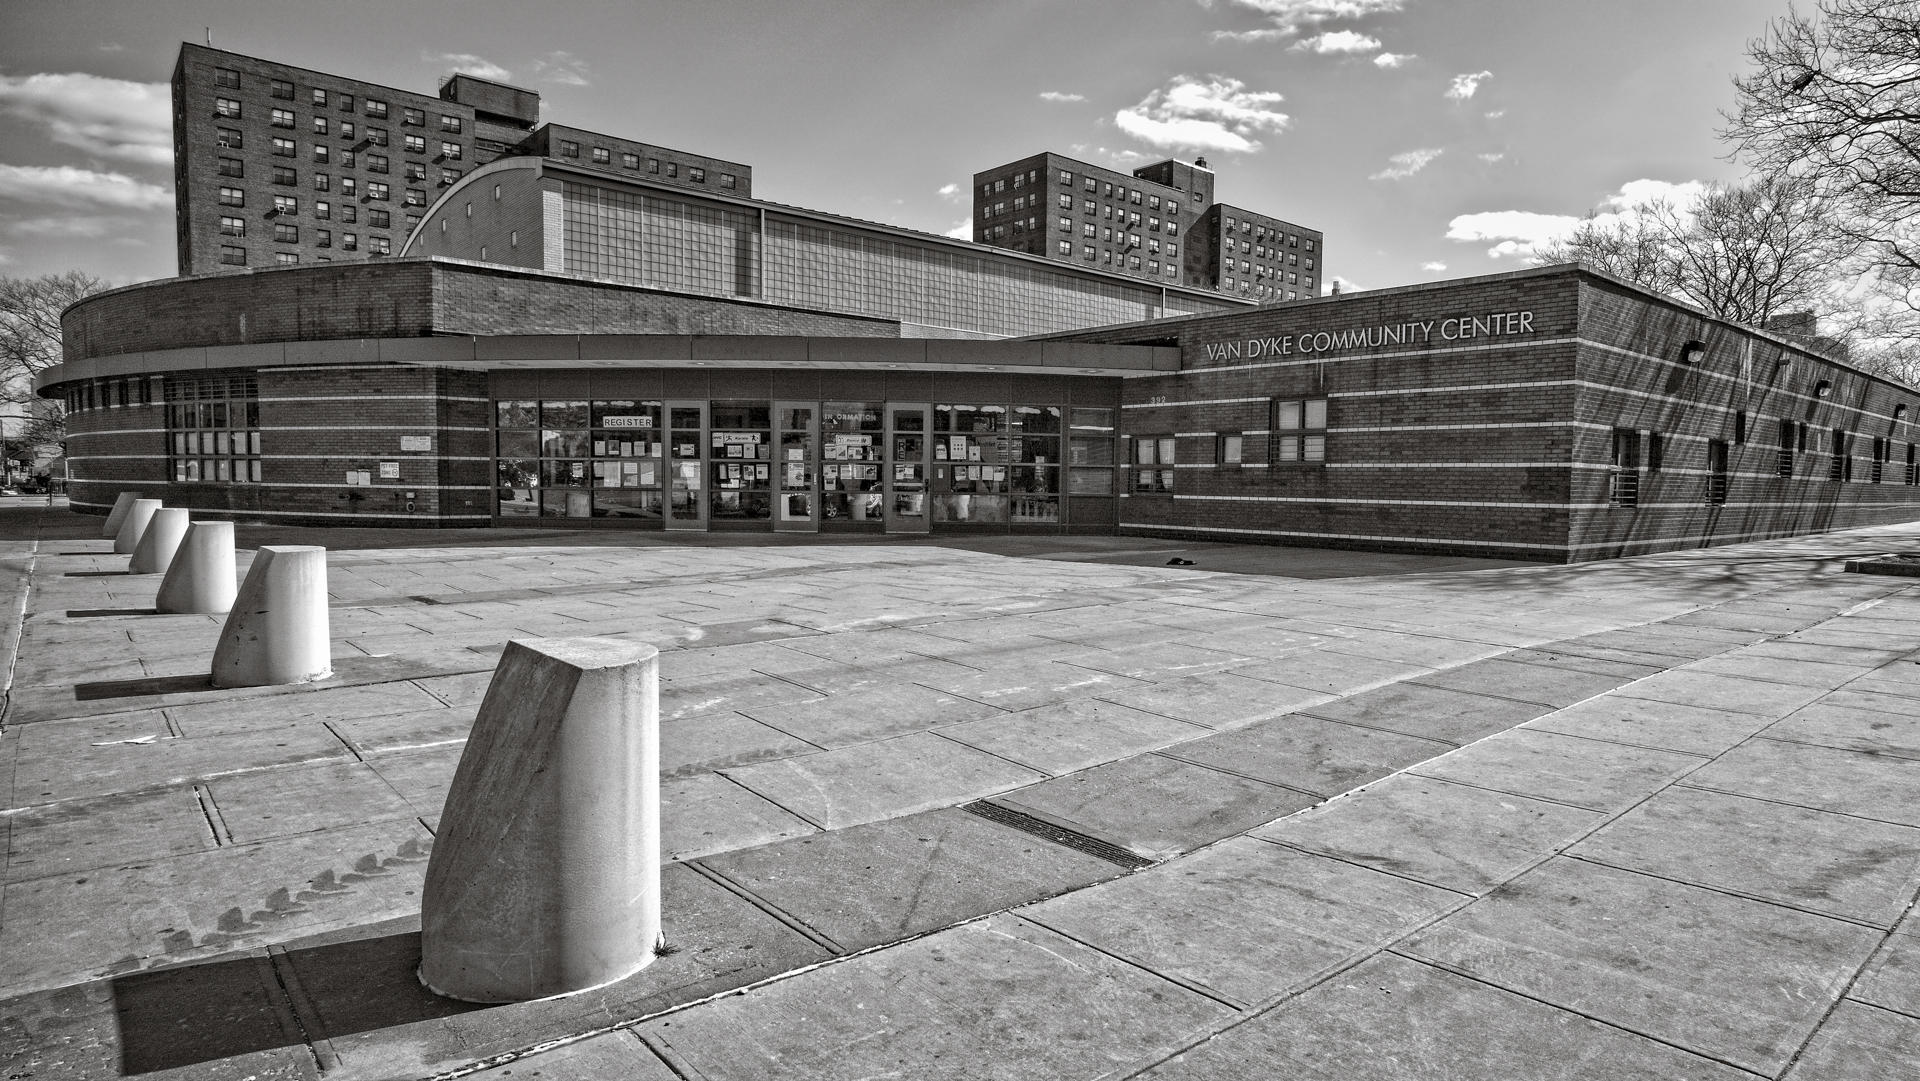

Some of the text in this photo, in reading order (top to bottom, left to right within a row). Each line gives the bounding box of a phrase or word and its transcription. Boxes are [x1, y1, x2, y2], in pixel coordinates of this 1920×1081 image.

[1206, 311, 1535, 361] VAN DYKE COMMUNITY CENTER
[824, 413, 877, 421] INORMATION
[604, 418, 652, 426] REGISTER
